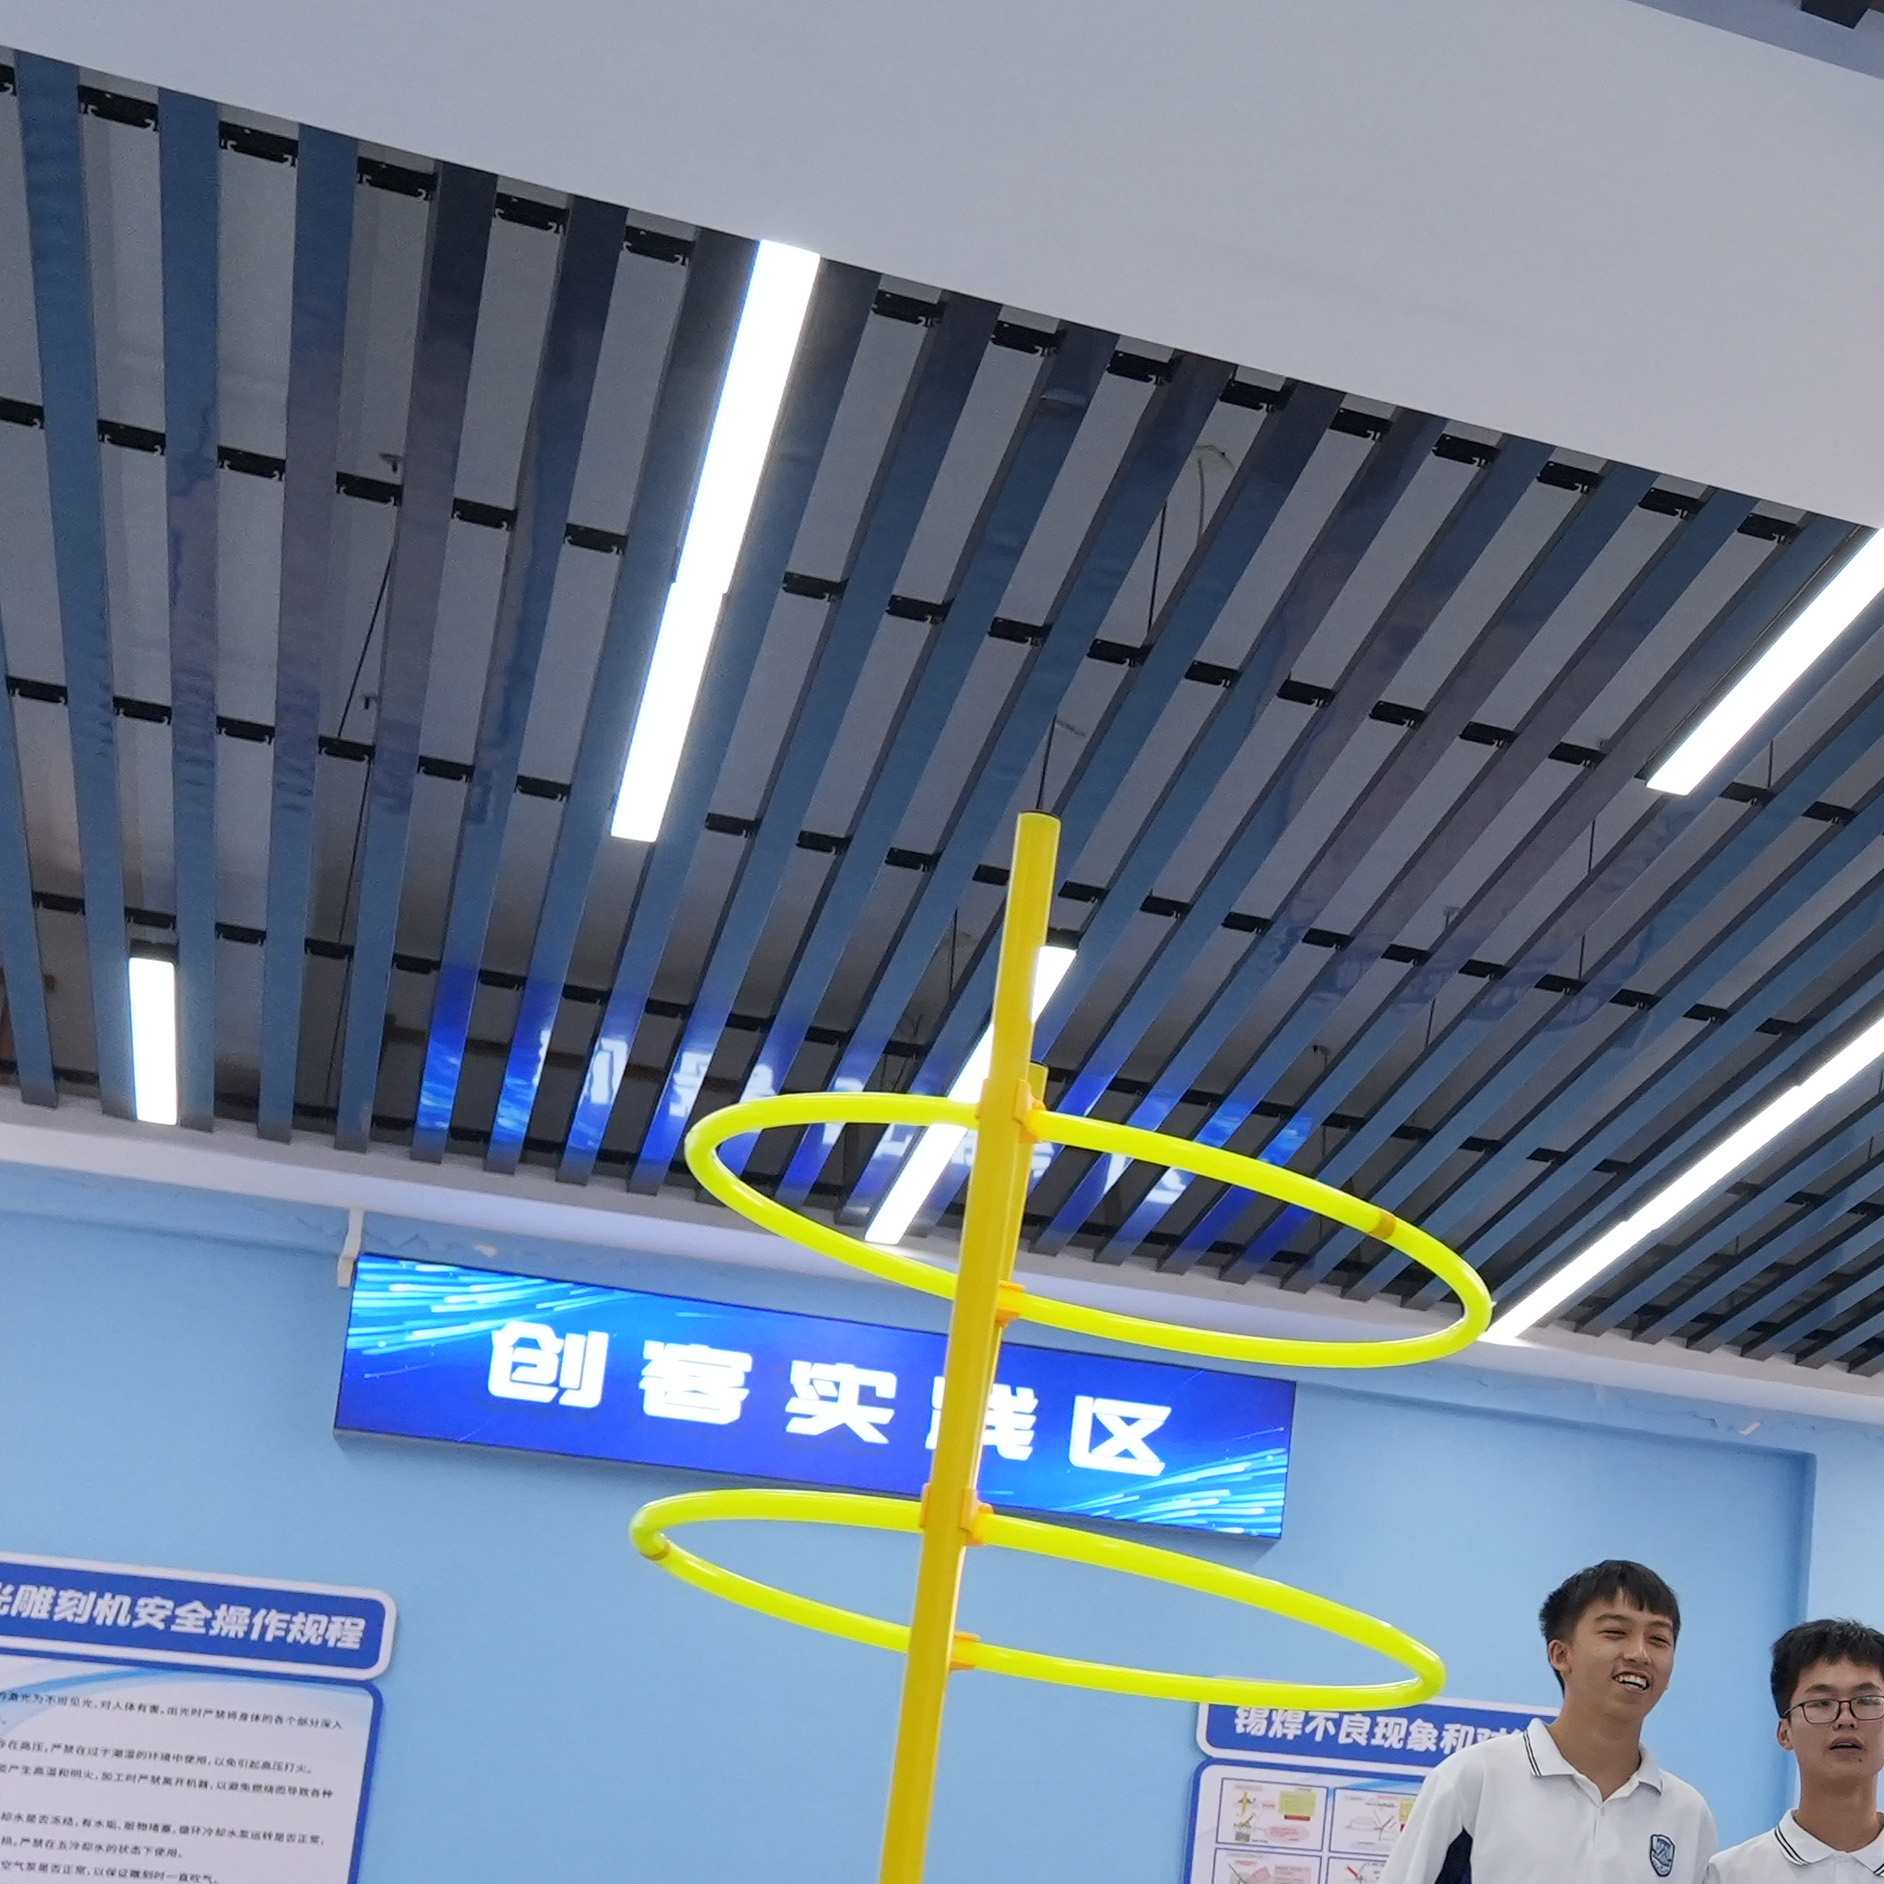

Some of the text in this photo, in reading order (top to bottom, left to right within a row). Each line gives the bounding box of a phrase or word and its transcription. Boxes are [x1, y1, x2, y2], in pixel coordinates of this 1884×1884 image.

[486, 1320, 1172, 1478] 创客实践区
[1234, 1706, 1520, 1755] 锡焊不良现象和
